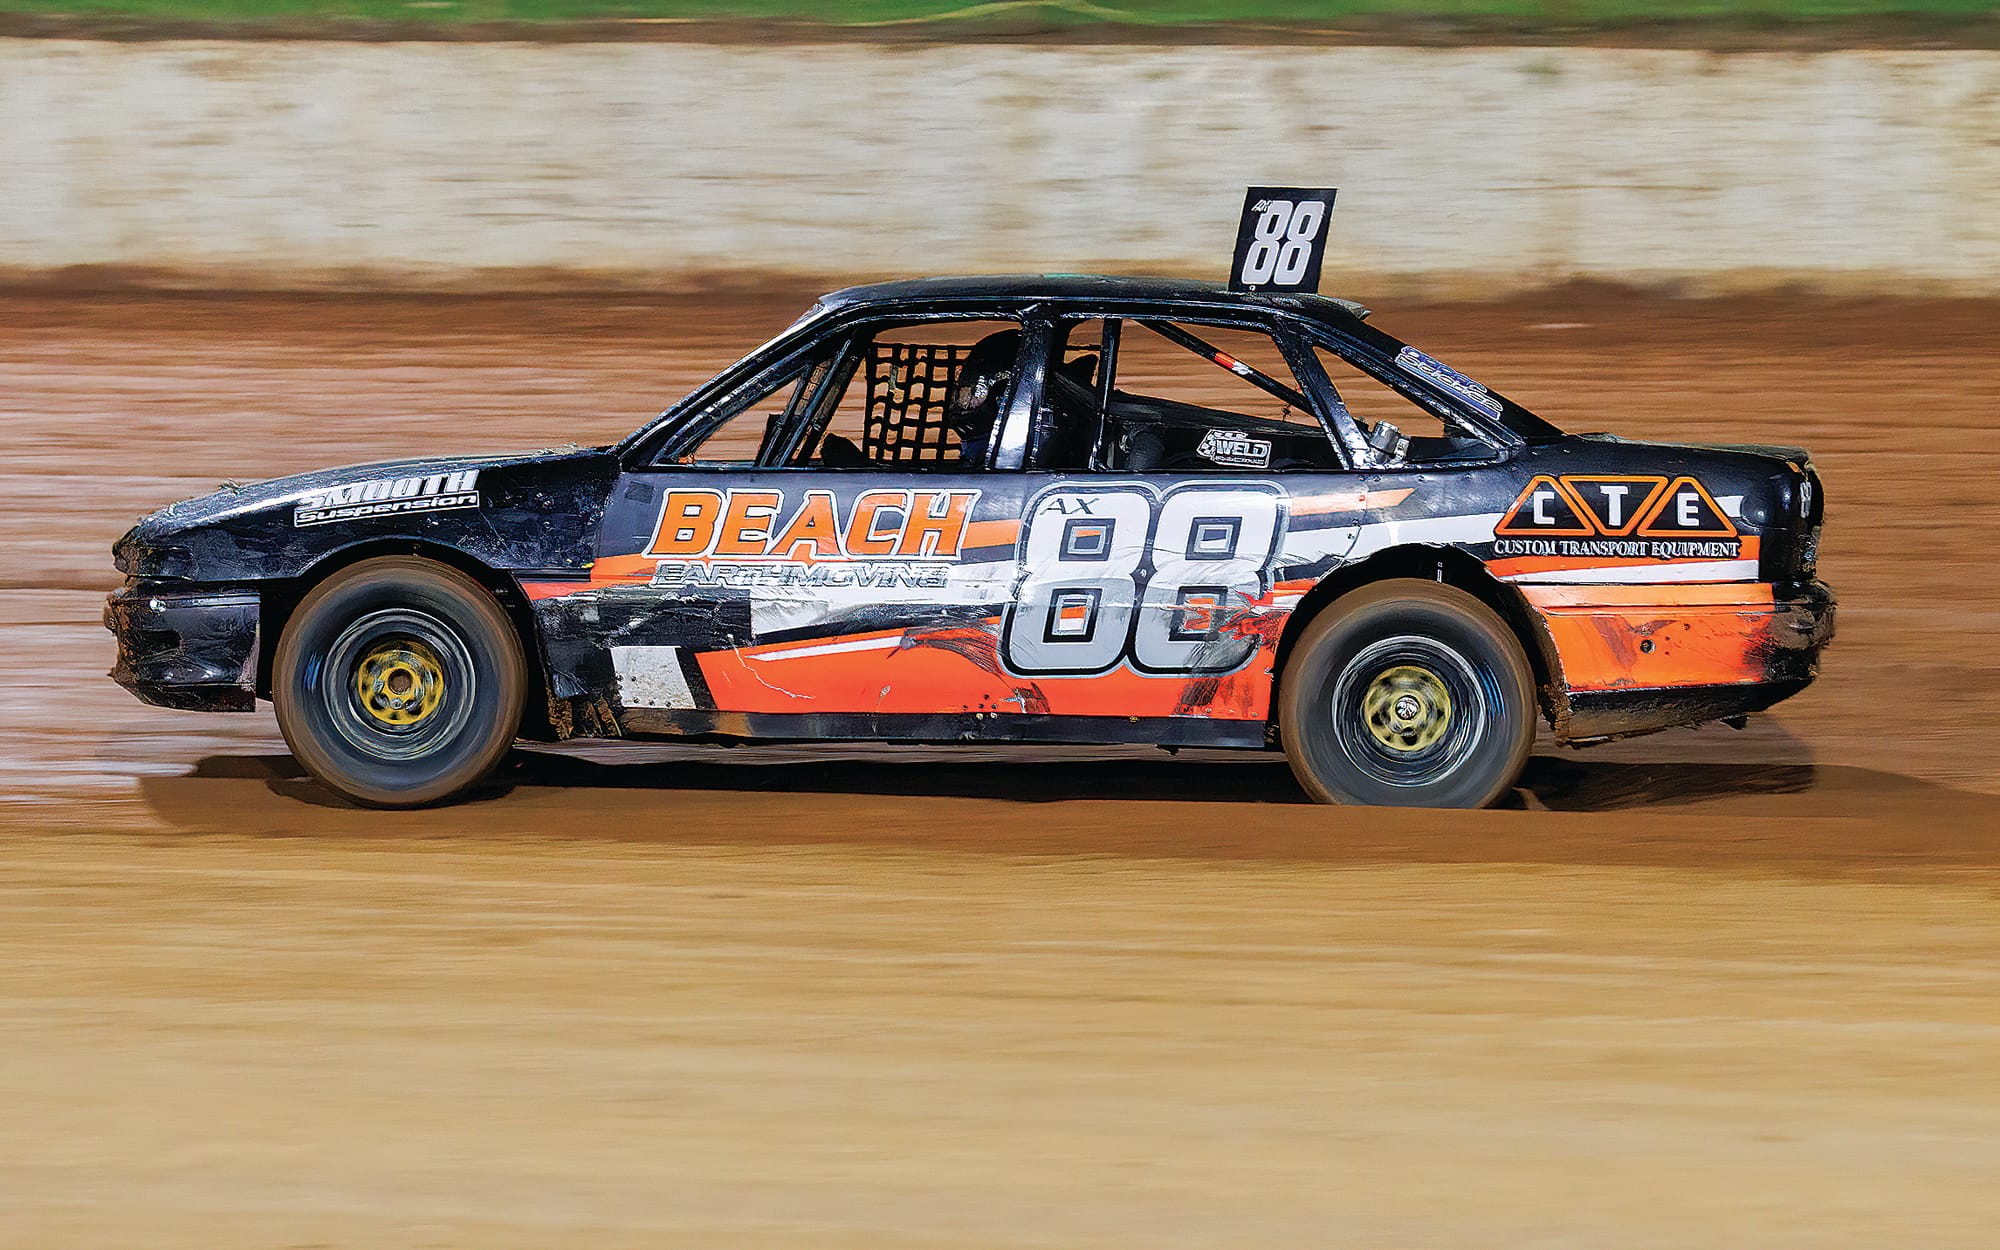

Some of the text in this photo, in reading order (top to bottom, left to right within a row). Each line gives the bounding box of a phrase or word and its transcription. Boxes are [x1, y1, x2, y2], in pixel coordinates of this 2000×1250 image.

[1241, 200, 1325, 285] 88
[1216, 440, 1268, 457] WELD
[297, 495, 476, 522] Suspension
[1039, 497, 1099, 515] AX
[642, 488, 981, 560] BEACH
[1494, 540, 1740, 559] CUSTOM TRANSPORT EQUIPMENT
[652, 561, 951, 588] EARTHMOVING
[1000, 481, 1288, 678] 88
